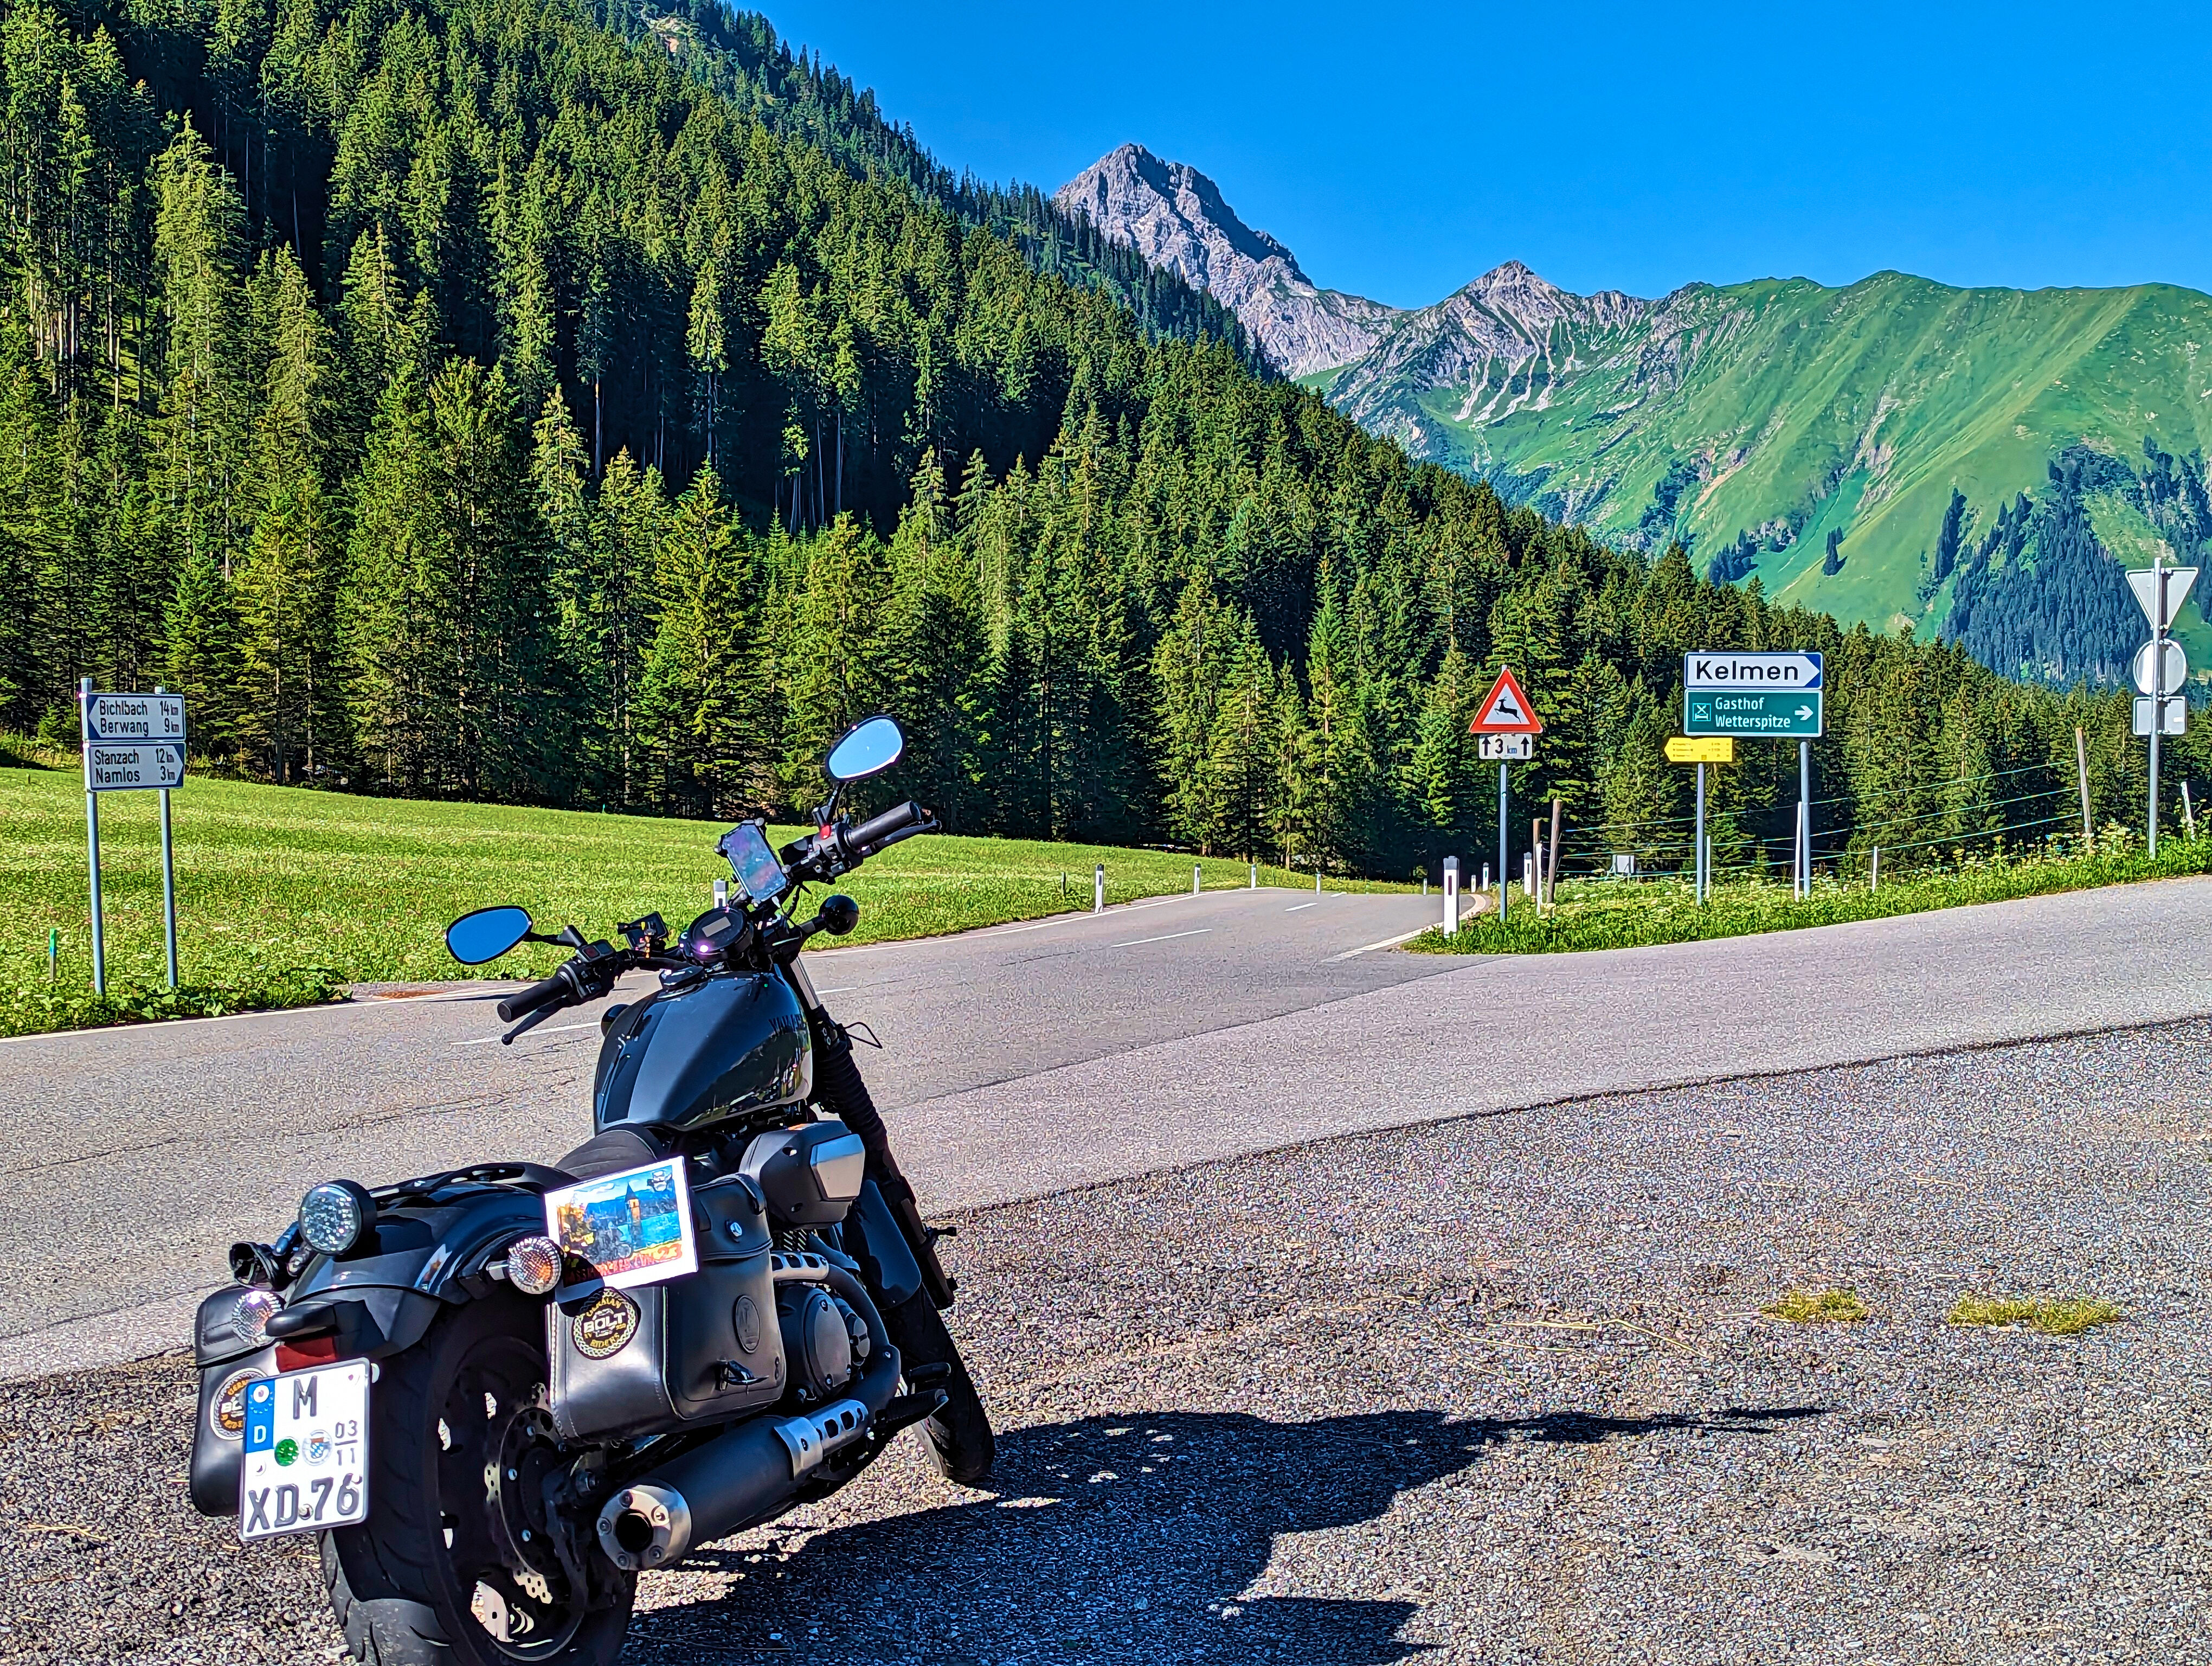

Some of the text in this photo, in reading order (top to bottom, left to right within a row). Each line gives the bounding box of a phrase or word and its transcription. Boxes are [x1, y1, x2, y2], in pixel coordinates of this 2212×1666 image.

[1696, 660, 1798, 681] Kelmen
[99, 700, 148, 716] Bichlbach
[159, 700, 170, 716] 14
[1715, 697, 1765, 710] Gasthof
[100, 717, 149, 737] Berwang
[164, 717, 170, 733] 9
[1715, 714, 1791, 731] Wetterspitze
[1495, 738, 1517, 754] 3 km
[94, 748, 139, 765] Stanzach
[156, 748, 165, 763] 12
[95, 767, 140, 783] Namlos
[160, 765, 166, 781] 3
[583, 1312, 626, 1334] BOLT
[293, 1375, 318, 1420] M
[253, 1425, 267, 1444] D
[335, 1420, 358, 1439] 03
[337, 1447, 356, 1466] 11
[247, 1473, 359, 1533] XD 76
